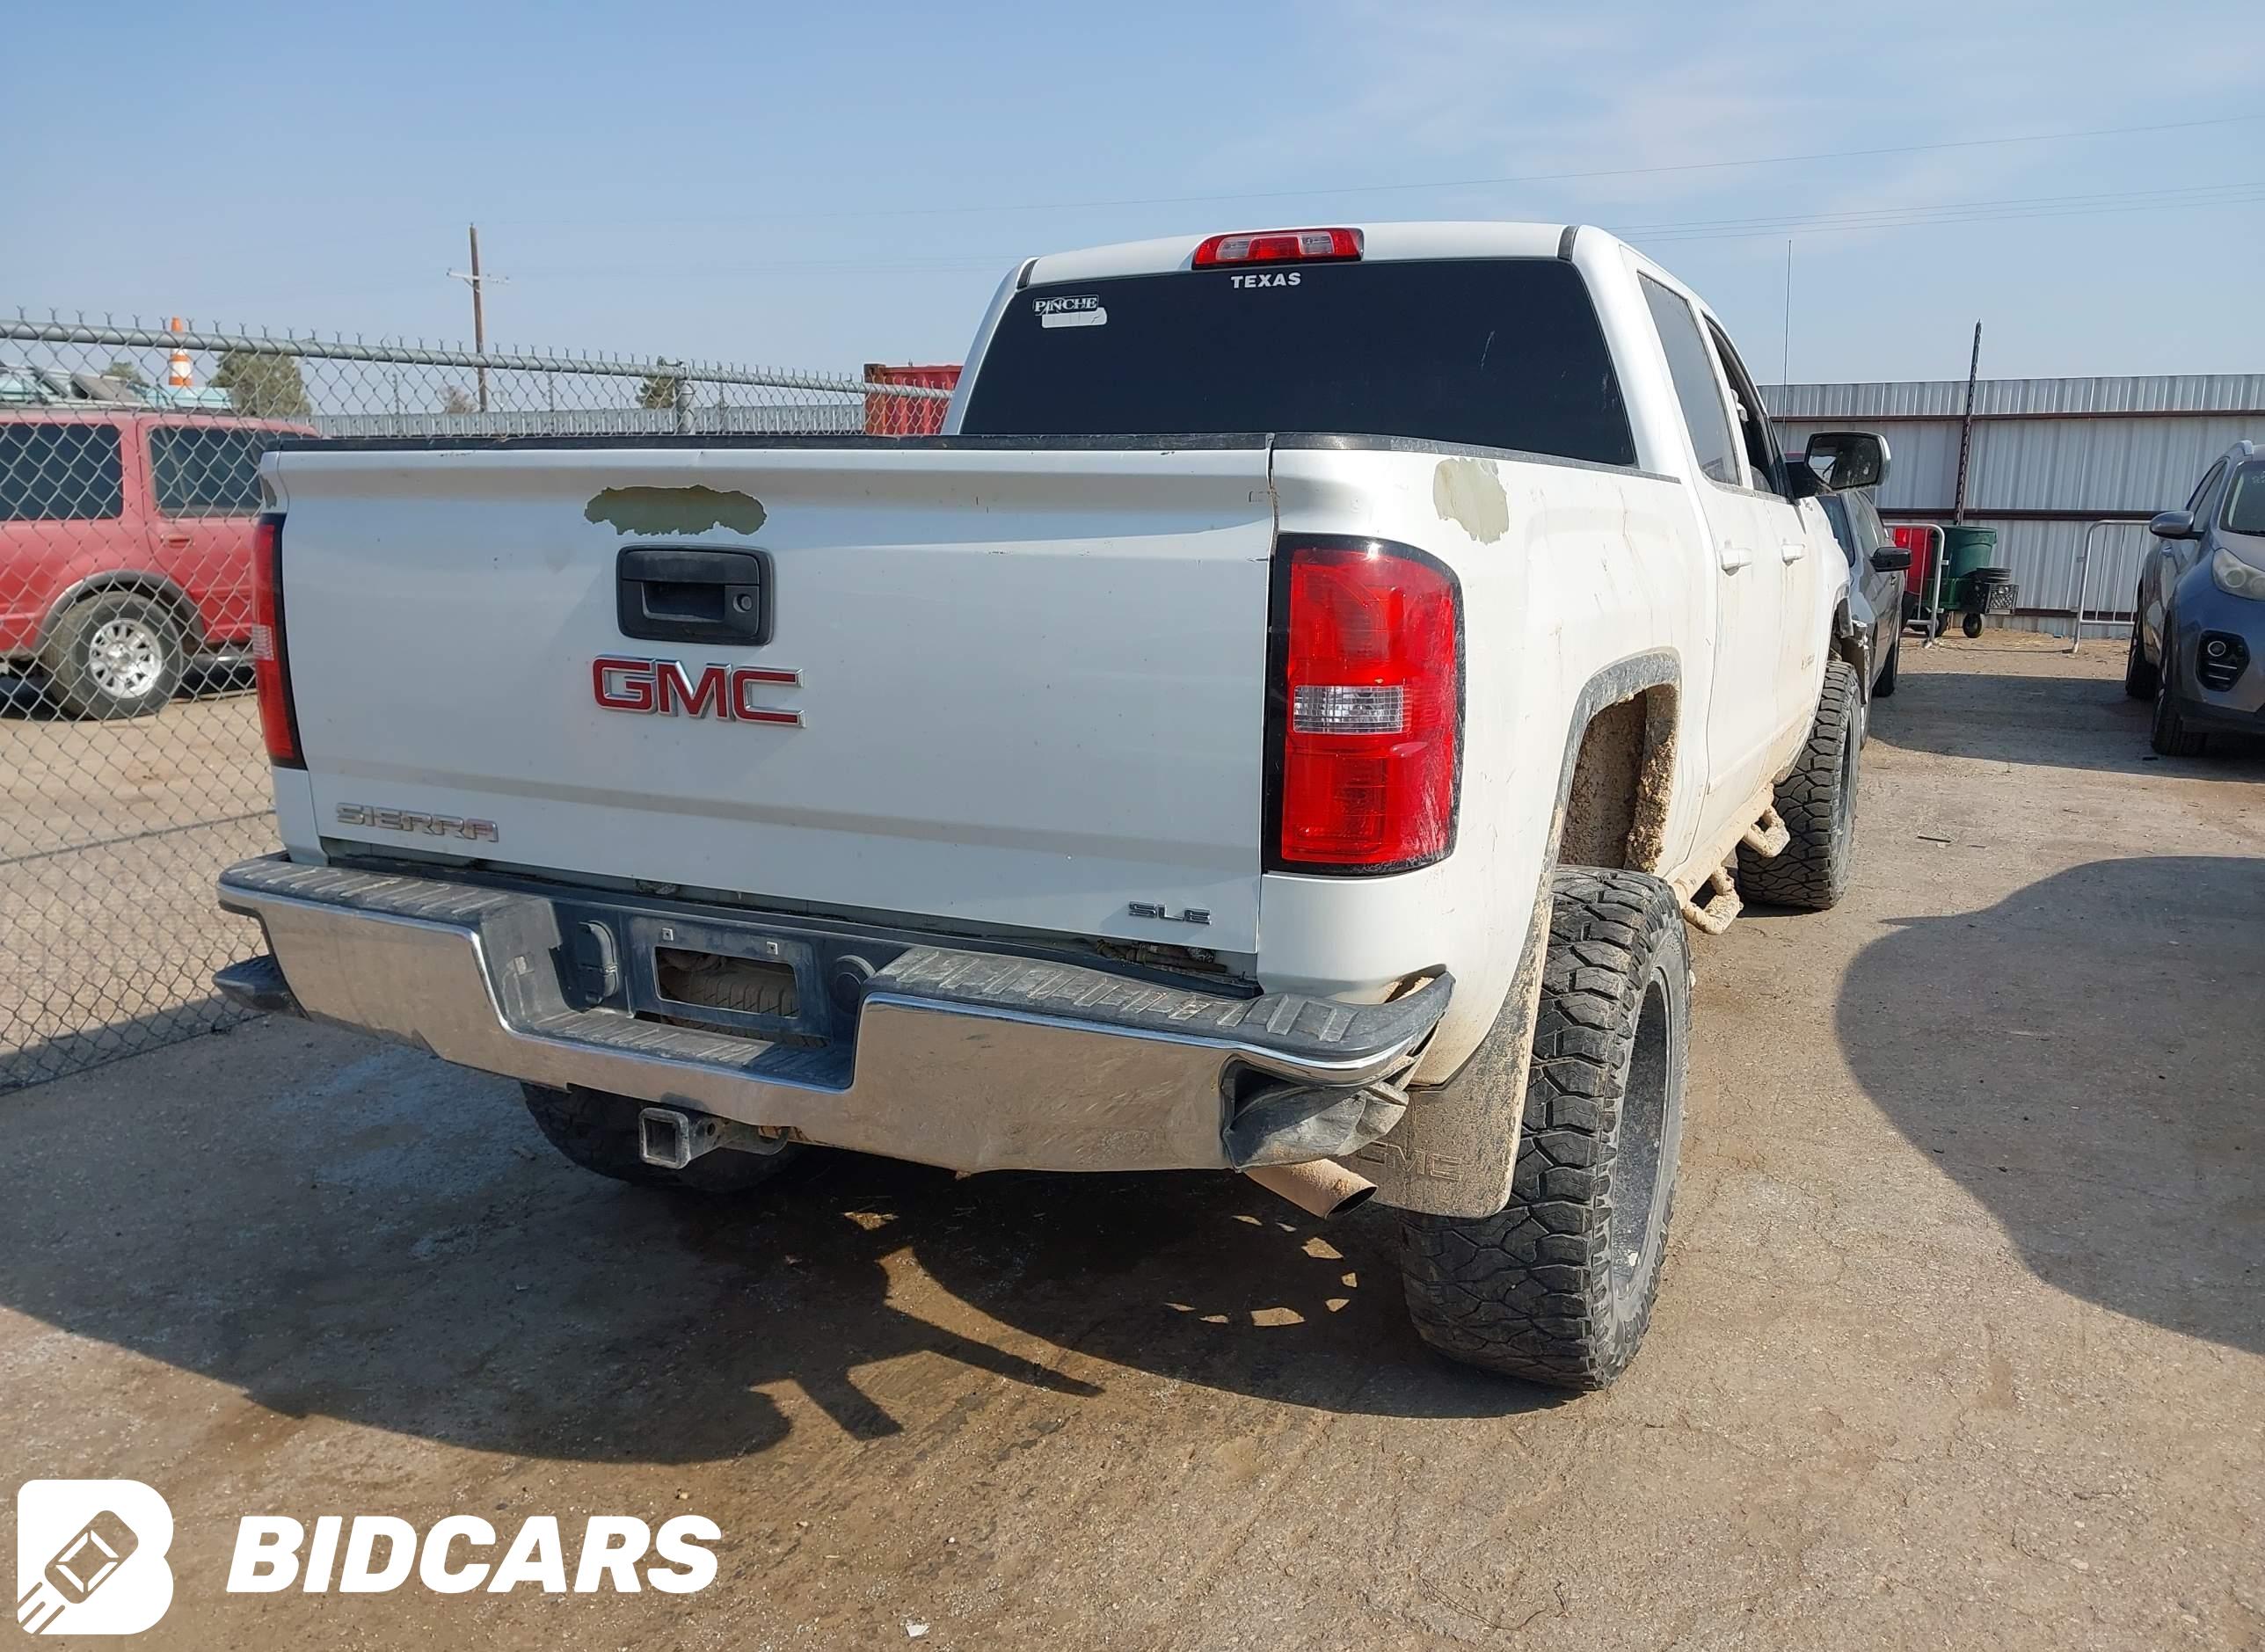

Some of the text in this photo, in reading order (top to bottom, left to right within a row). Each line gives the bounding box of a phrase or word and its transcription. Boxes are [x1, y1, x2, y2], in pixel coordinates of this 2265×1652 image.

[1231, 272, 1301, 288] TEXAS
[593, 654, 806, 728] GMC
[337, 802, 499, 842] SIERRA
[1128, 900, 1213, 925] SLE
